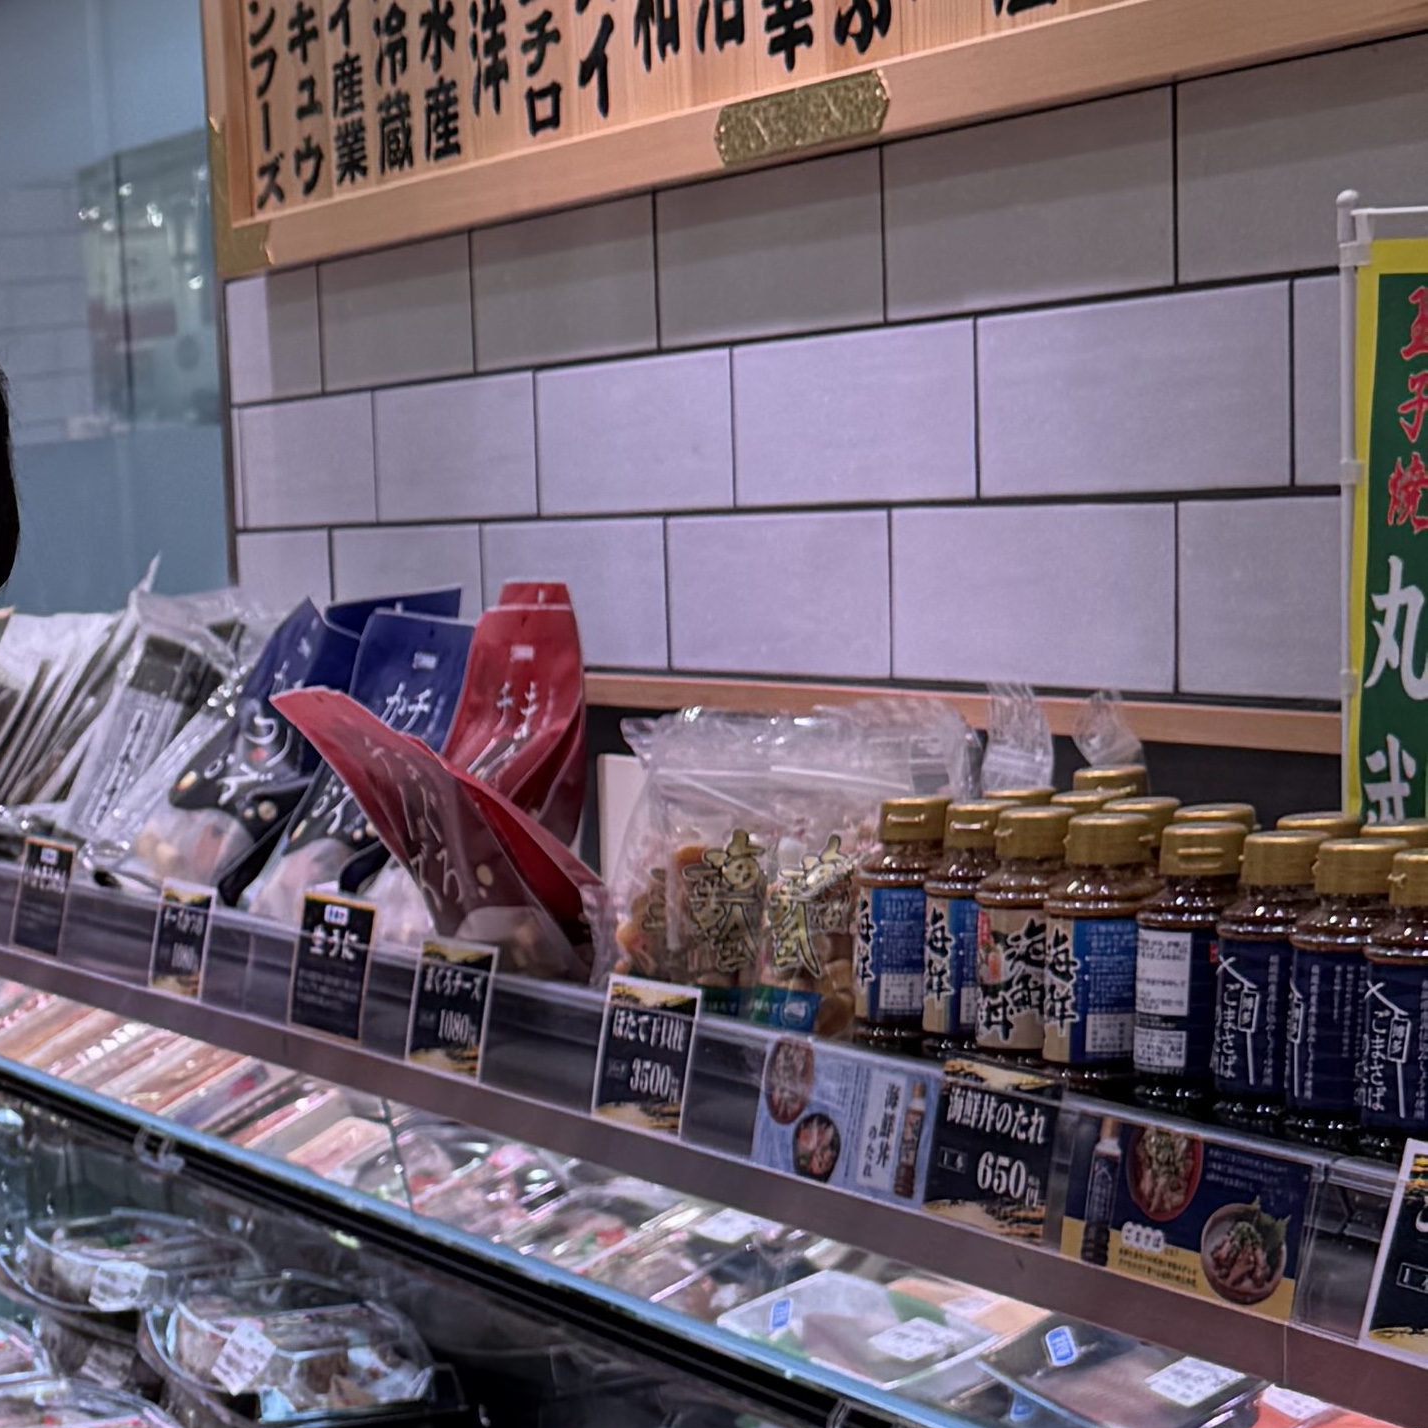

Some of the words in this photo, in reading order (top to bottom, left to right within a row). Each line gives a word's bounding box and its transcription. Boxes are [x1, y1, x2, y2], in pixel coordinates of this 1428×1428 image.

[419, 0, 462, 163] 水産
[520, 0, 562, 138] チロ
[575, 0, 615, 119] イ
[946, 1085, 1046, 1145] 海鮮丼のたれ
